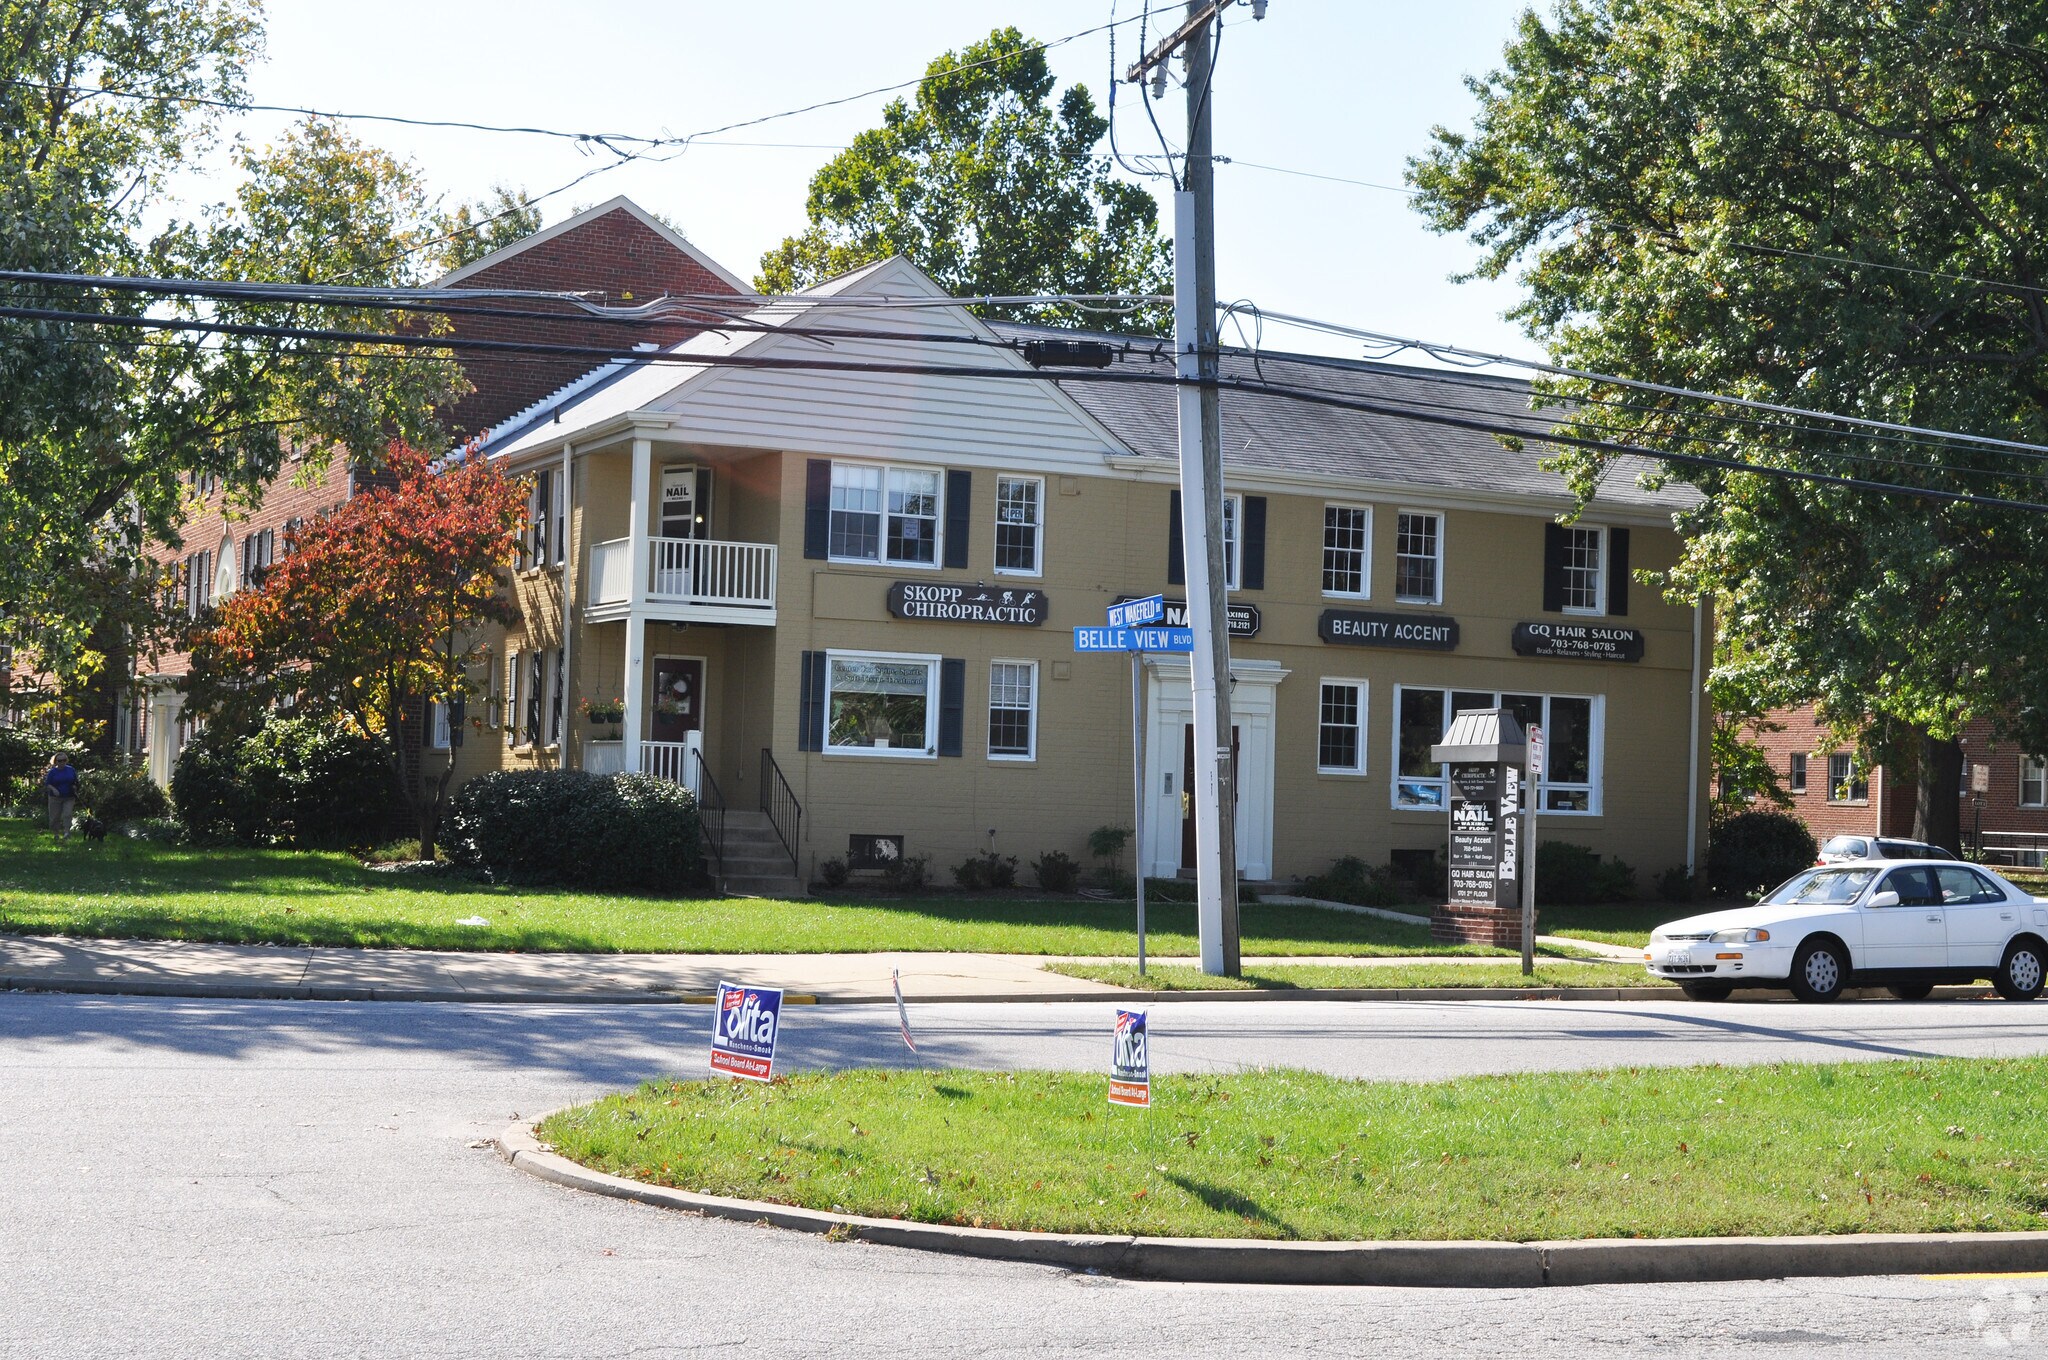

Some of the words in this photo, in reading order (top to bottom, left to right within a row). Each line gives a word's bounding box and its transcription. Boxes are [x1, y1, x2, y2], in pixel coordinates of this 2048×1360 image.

[666, 487, 689, 497] NAIL
[904, 585, 962, 603] SKOPP
[903, 601, 1036, 623] CHIROPRACTIC
[1109, 606, 1123, 627] WEST
[1125, 600, 1155, 623] WAKEFIELD
[1167, 608, 1189, 625] NA
[1228, 611, 1250, 619] XING
[1079, 630, 1127, 648] BELLE
[1134, 631, 1169, 648] VIEW
[1174, 635, 1192, 645] BLVD
[1333, 620, 1388, 637] BEAUTY
[1394, 624, 1450, 641] ACCENT
[1529, 624, 1550, 637] GQ
[1555, 626, 1586, 638] HAIR
[1592, 629, 1633, 641] SALON
[1551, 639, 1616, 651] 703-768-0785
[1584, 650, 1602, 659] Styling
[1500, 766, 1519, 817] VIEW
[1454, 810, 1494, 821] NAIL
[1455, 836, 1472, 844] Beauty
[1473, 836, 1491, 844] Accent
[1499, 817, 1517, 881] BELLE
[1451, 870, 1460, 878] GQ
[1461, 870, 1474, 878] HAIR
[1476, 871, 1495, 879] SALON
[1453, 880, 1492, 889] 703-768-0785
[714, 988, 774, 1047] Lolita
[713, 1053, 731, 1065] School
[730, 1057, 745, 1068] Board
[744, 1060, 768, 1074] At-Large
